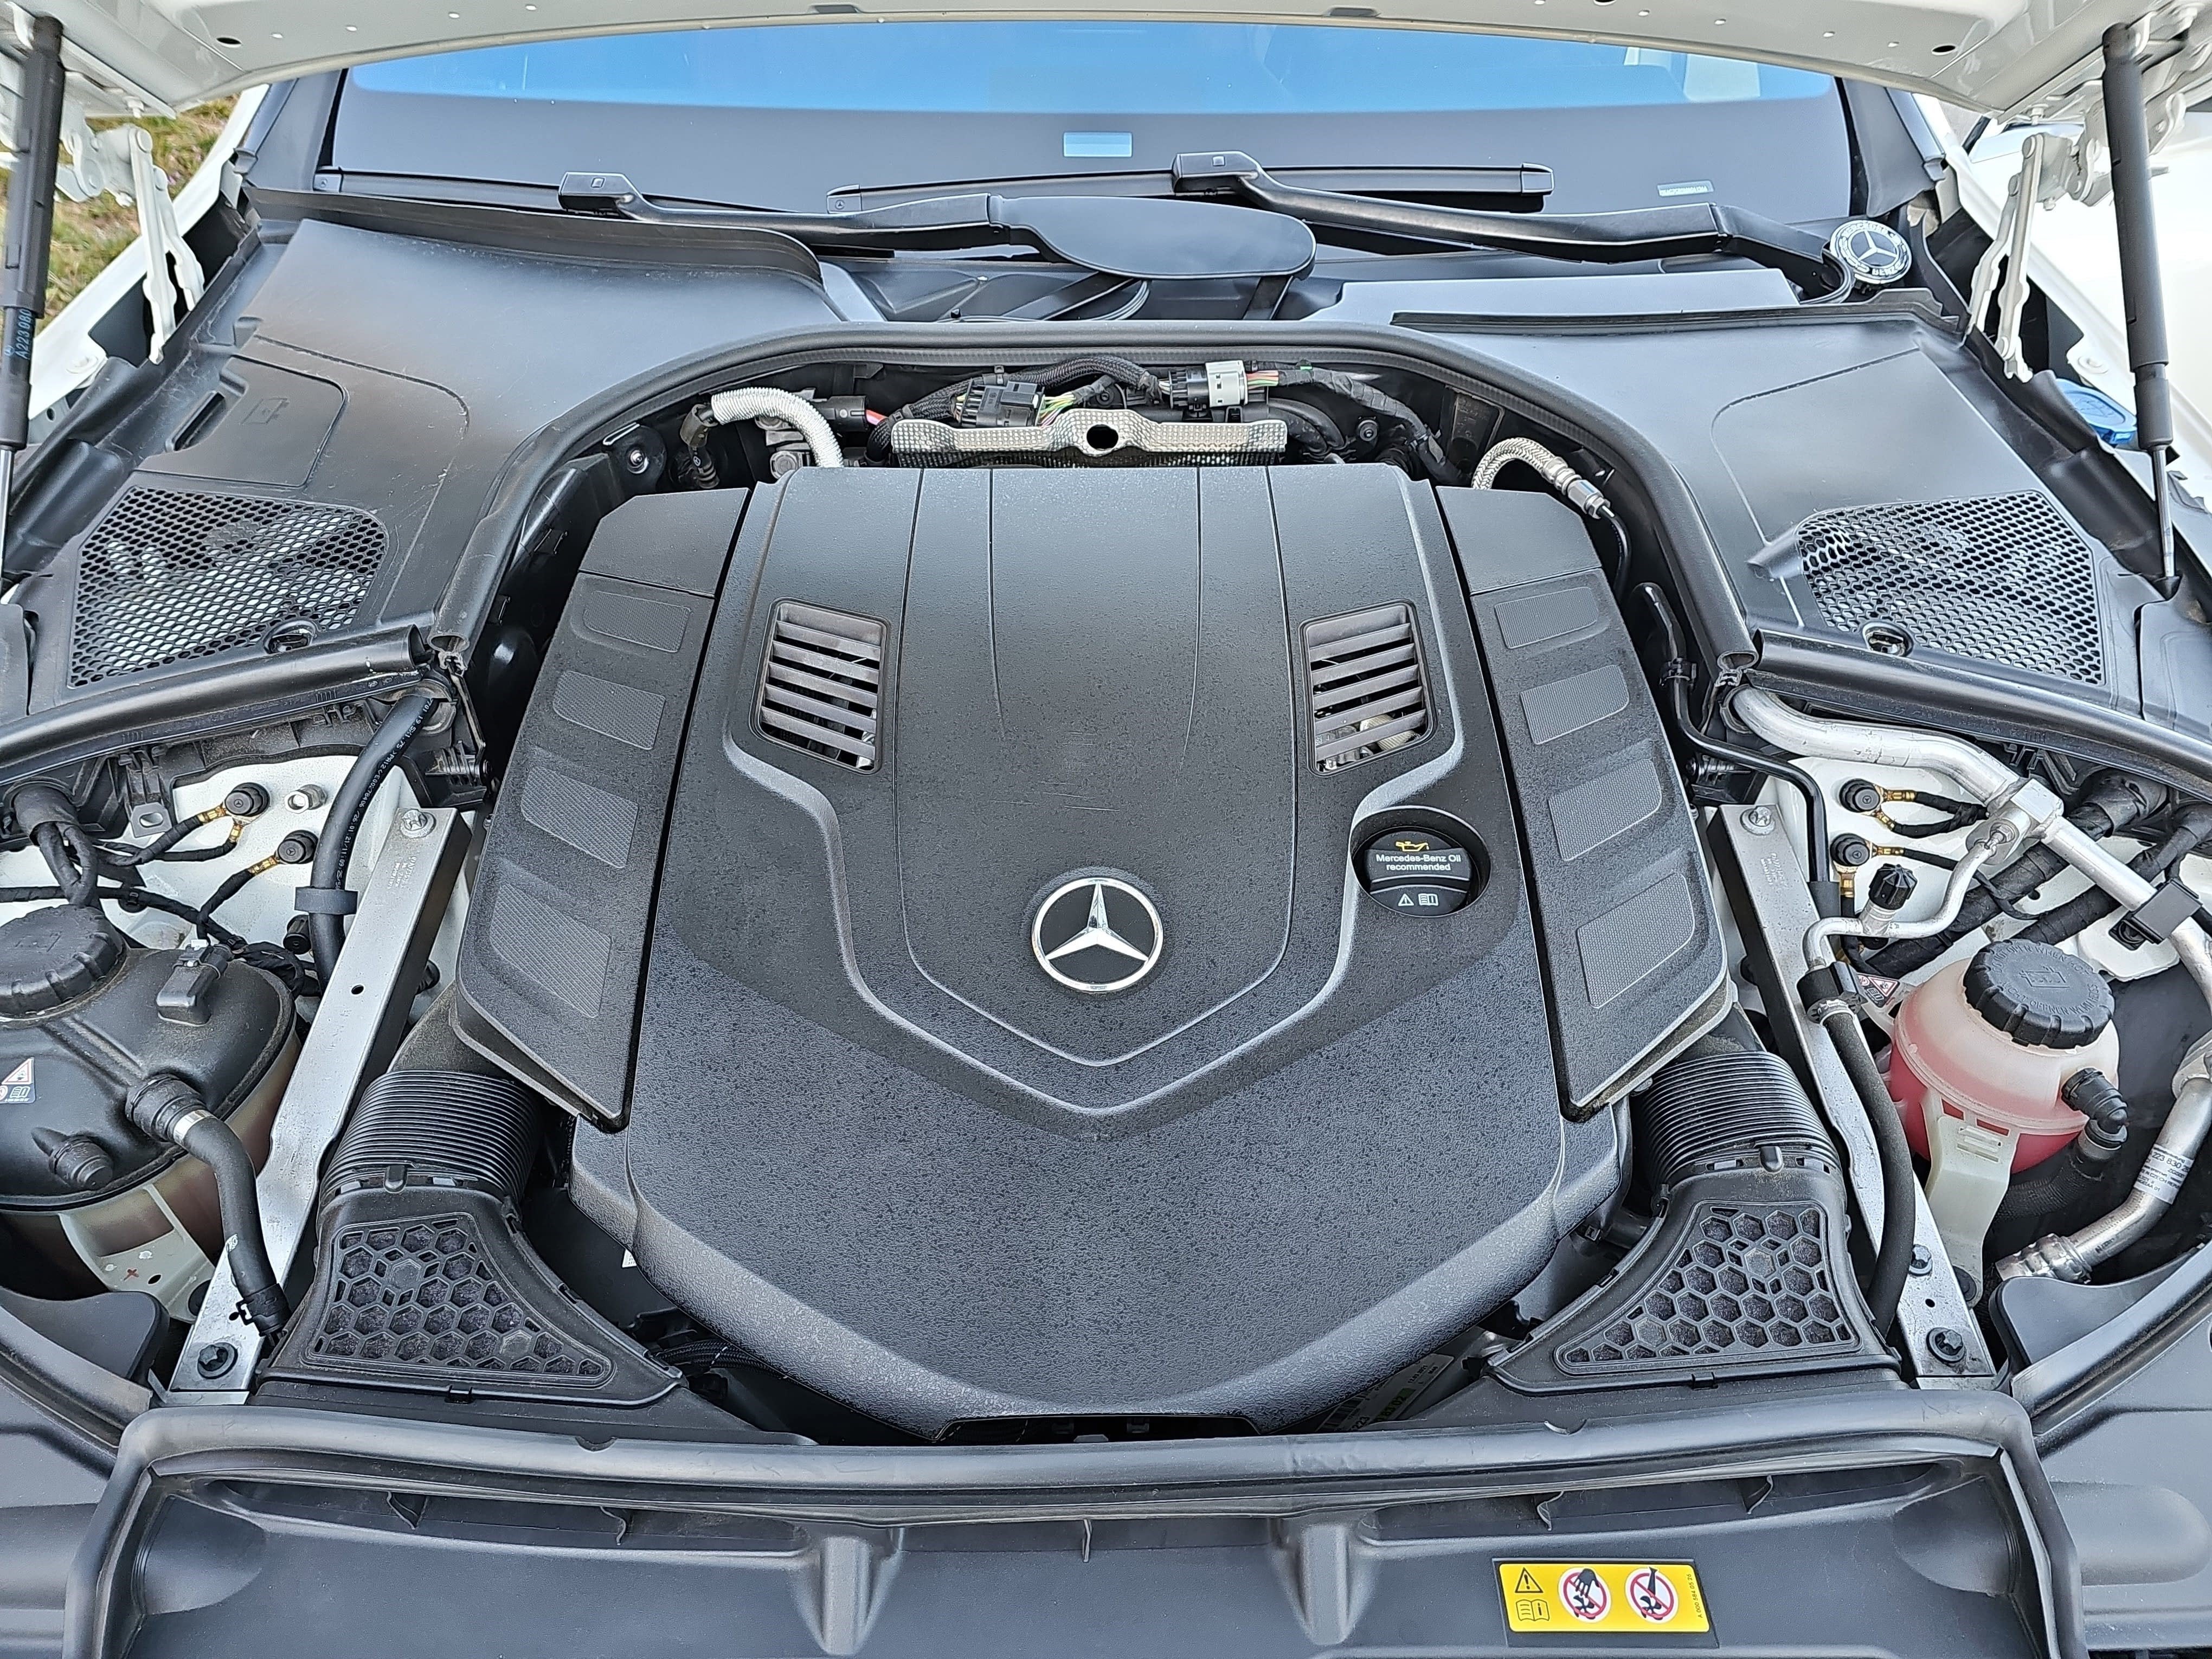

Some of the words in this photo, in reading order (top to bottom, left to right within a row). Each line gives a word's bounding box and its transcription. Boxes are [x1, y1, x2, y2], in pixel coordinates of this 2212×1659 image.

[1376, 854, 1446, 862] Mercedes-Benz
[2152, 1152, 2165, 1161] 223
[2166, 1158, 2182, 1169] 830
